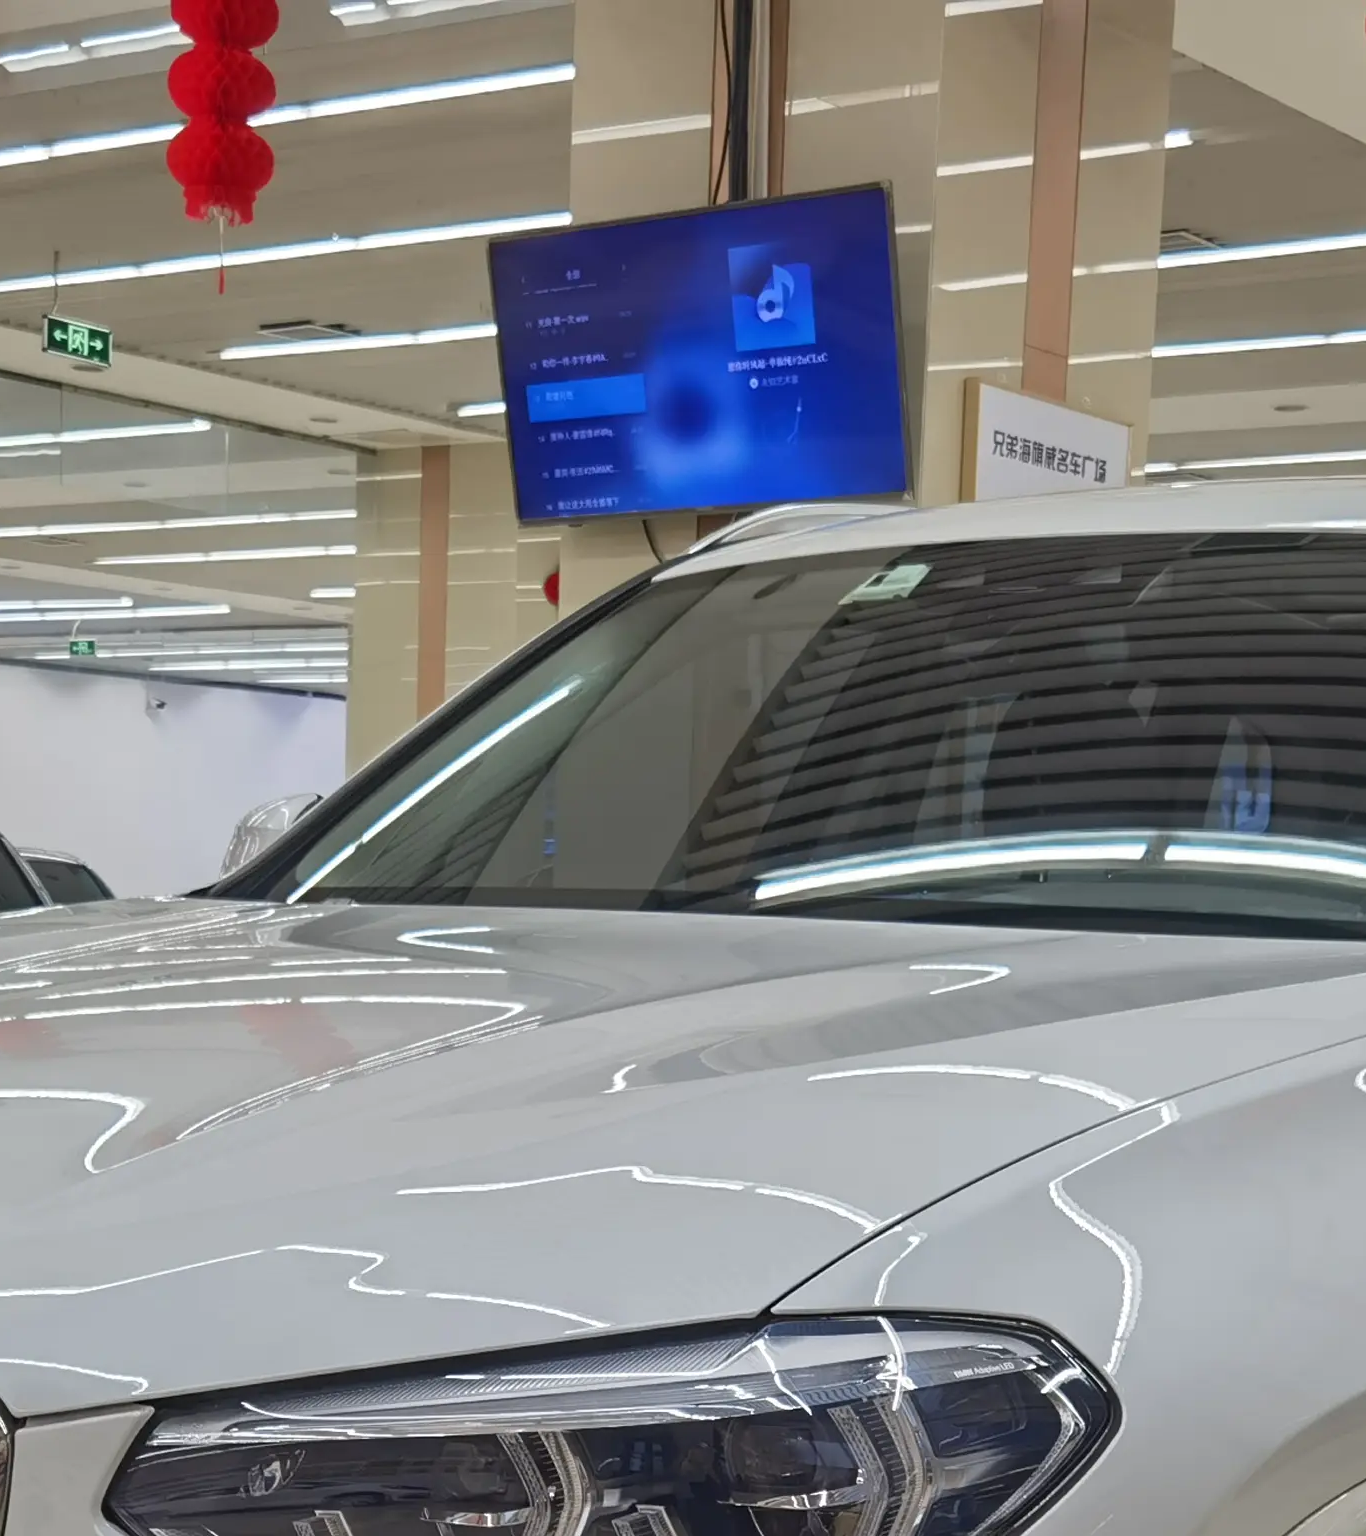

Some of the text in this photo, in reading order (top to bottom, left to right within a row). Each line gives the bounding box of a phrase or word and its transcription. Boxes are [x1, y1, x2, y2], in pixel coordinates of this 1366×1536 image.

[992, 429, 1107, 484] 兄弟海旗威名车广场
